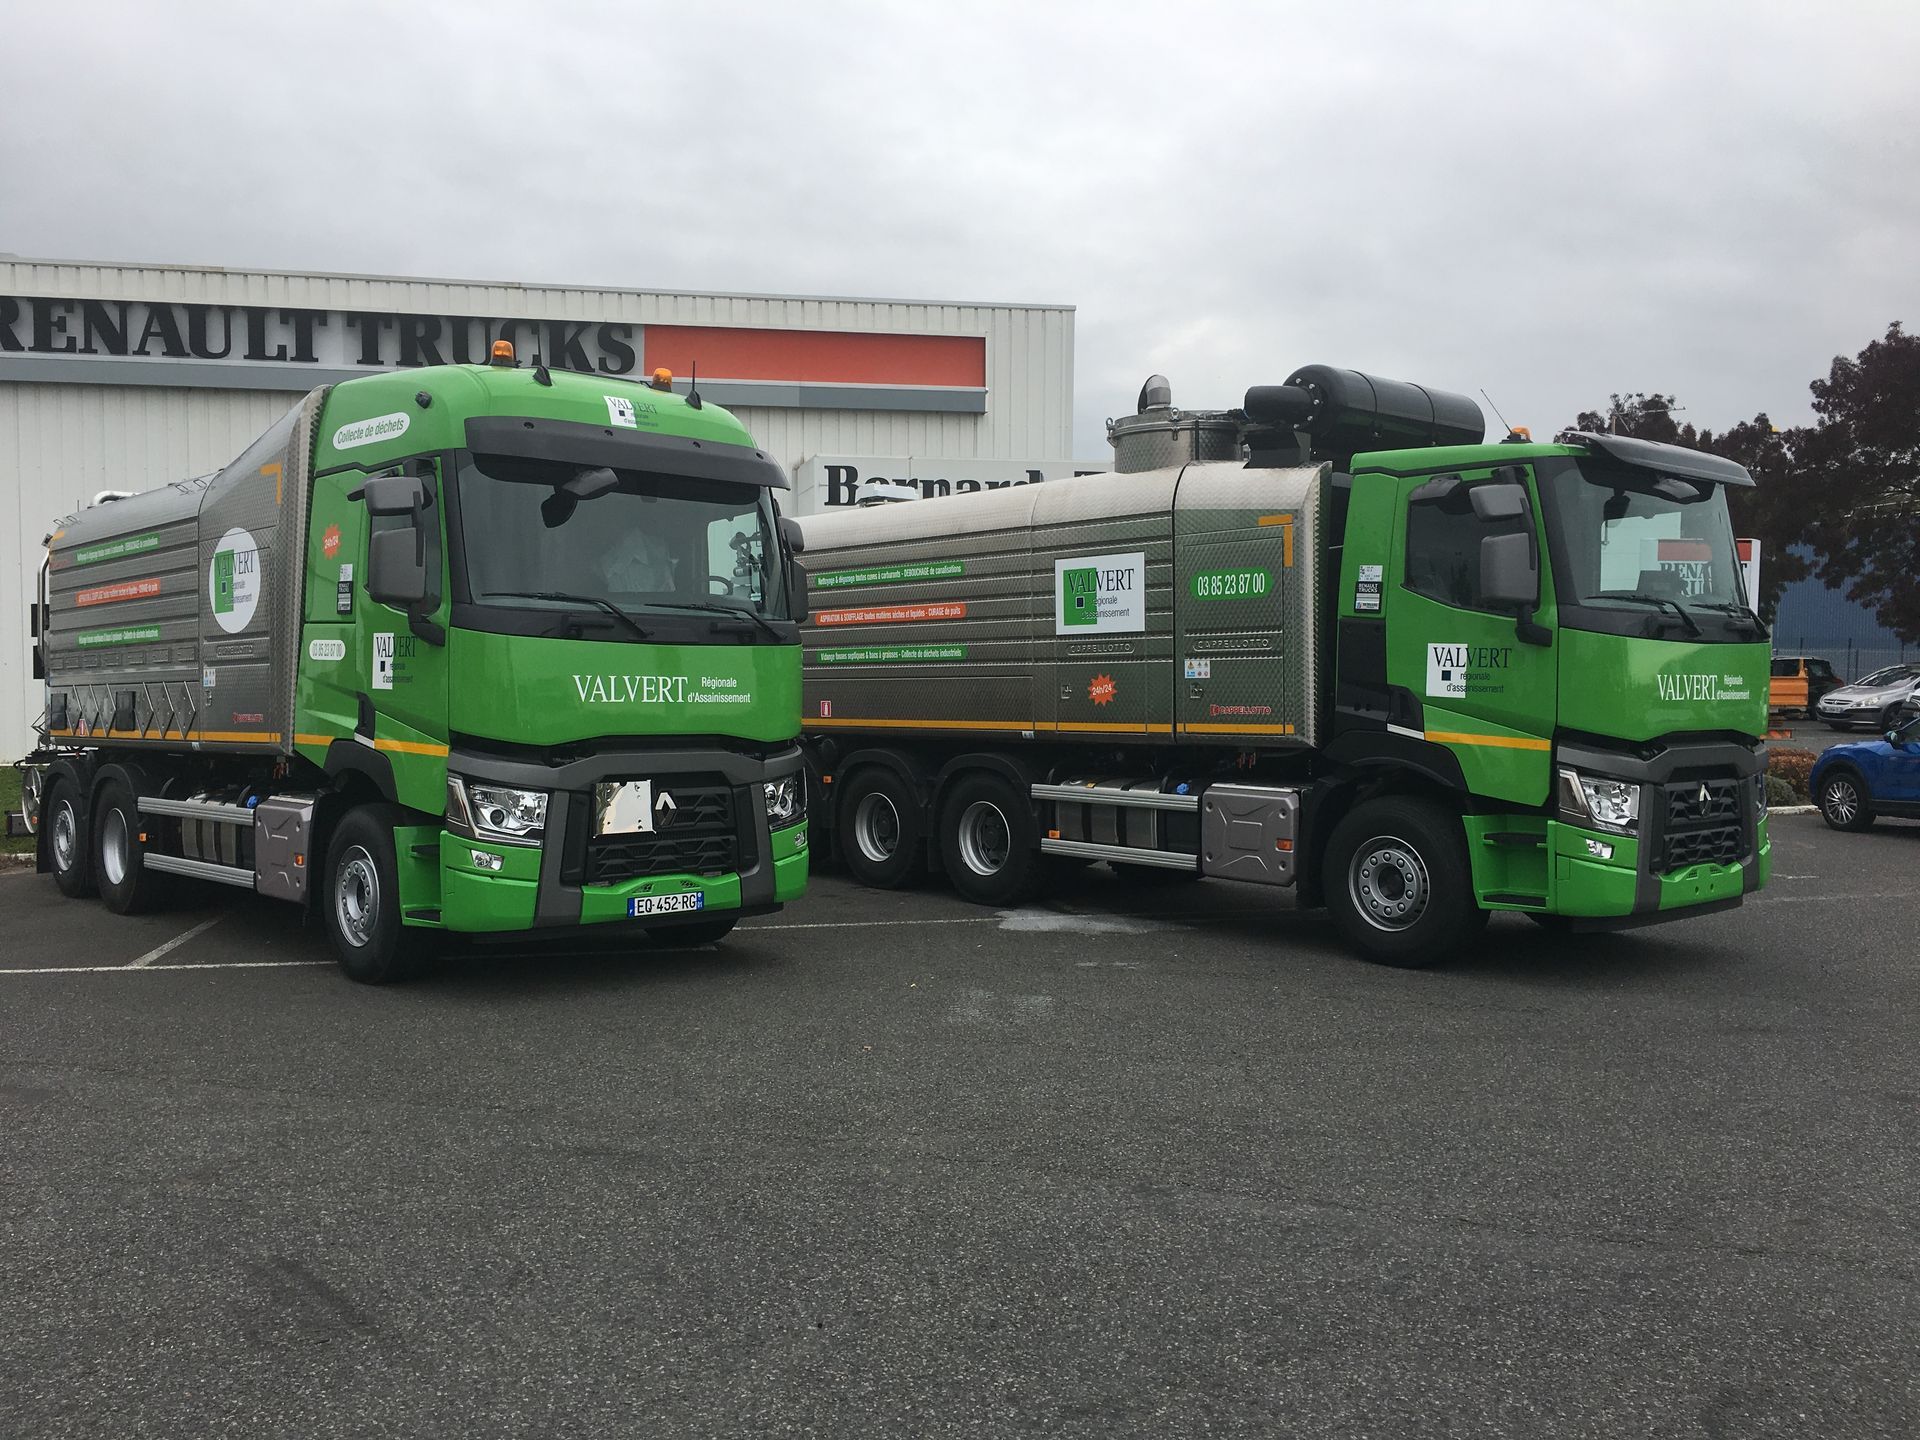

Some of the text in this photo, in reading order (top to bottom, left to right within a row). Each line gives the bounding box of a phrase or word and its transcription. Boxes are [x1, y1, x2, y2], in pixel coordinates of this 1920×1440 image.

[347, 312, 636, 376] TRUCKS
[337, 418, 405, 444] Collecte de déchets
[1068, 568, 1134, 594] VALVERT
[1197, 572, 1265, 596] 03 85 23 87 00
[376, 636, 416, 658] VALVERT
[1198, 638, 1269, 649] CAPPELLOTTO
[1433, 646, 1513, 668] VALVERT
[572, 674, 689, 703] VALVERT
[701, 676, 737, 690] Régionale
[1092, 683, 1113, 696] 24h/24
[1656, 674, 1719, 701] VALVERT
[687, 691, 752, 703] d'Assainissement
[1219, 705, 1272, 715] CAPPELLOTTO
